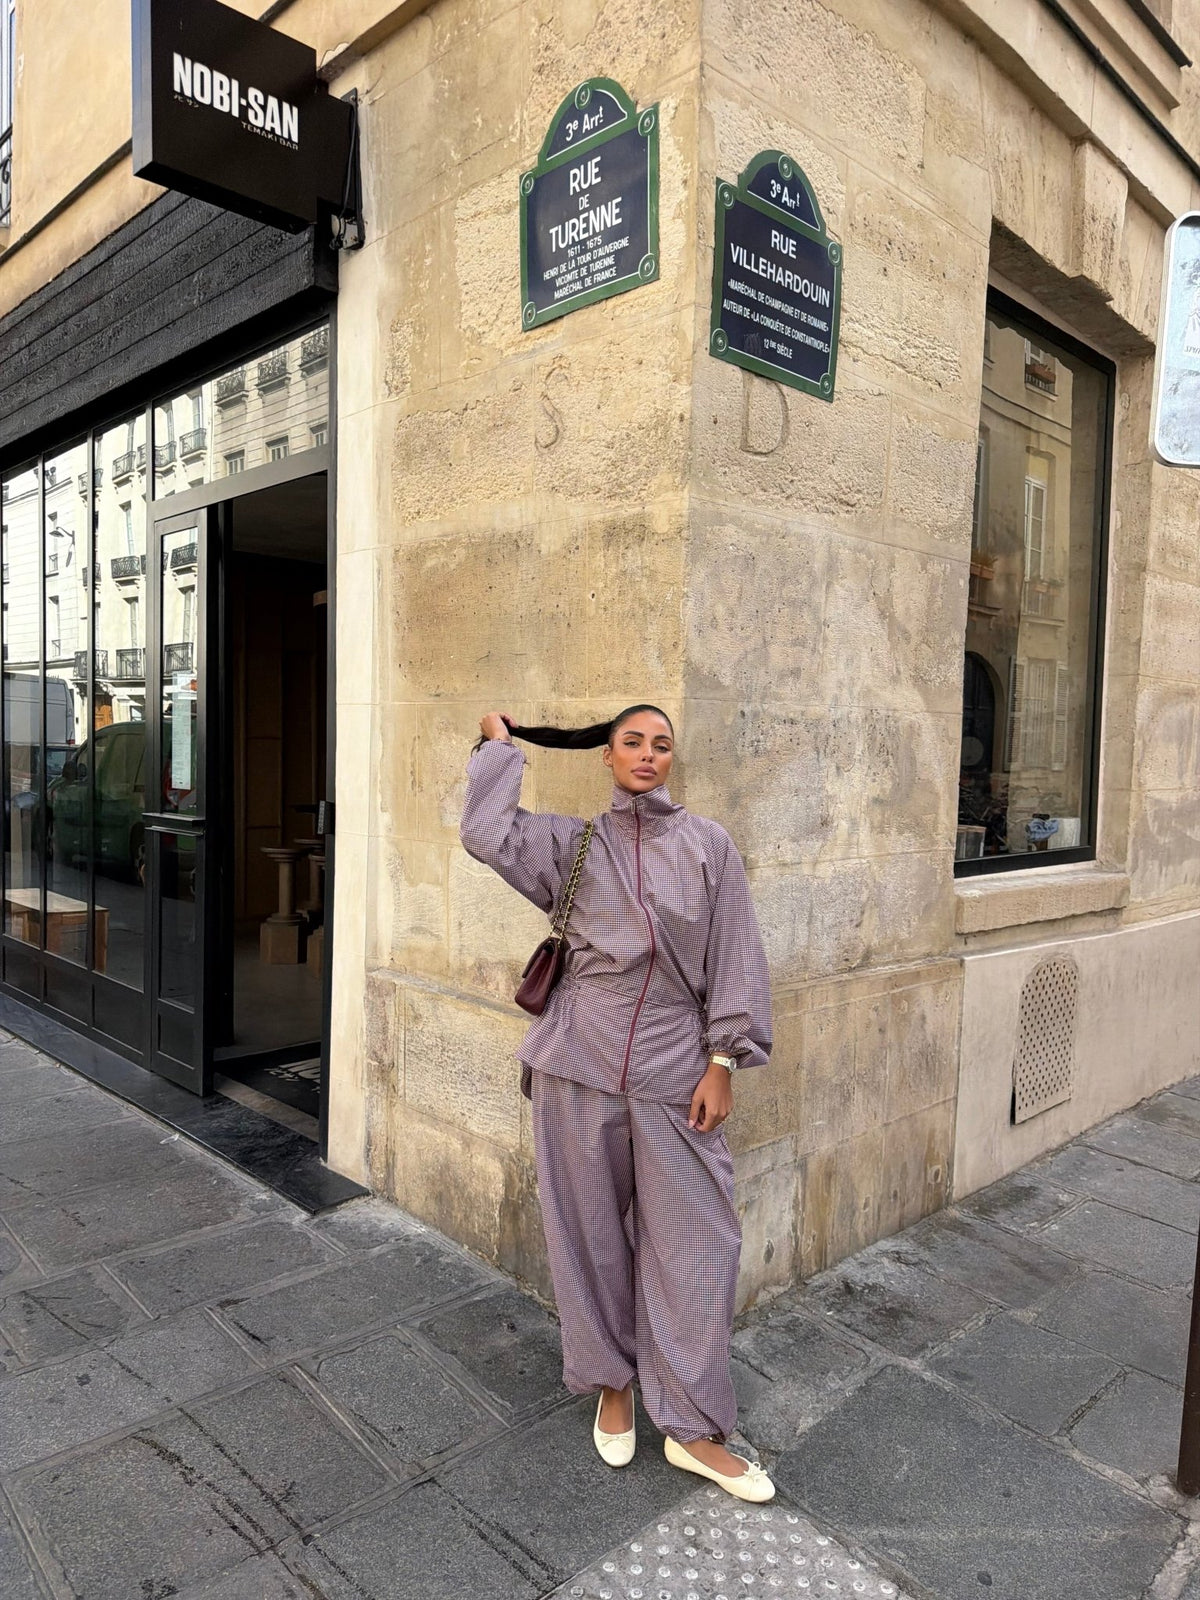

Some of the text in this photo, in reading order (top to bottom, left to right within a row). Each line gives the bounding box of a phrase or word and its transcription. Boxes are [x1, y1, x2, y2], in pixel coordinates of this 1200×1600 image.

[173, 51, 299, 144] NOBI-SAN
[241, 121, 299, 151] TEMAKI BAR
[565, 119, 579, 142] 3e
[569, 156, 602, 196] RUE
[770, 179, 782, 199] 3e
[578, 193, 590, 211] DE
[549, 197, 622, 253] TURENNE
[543, 236, 630, 281] HENRI DE LA TOUR D'AUVERGNE
[567, 244, 581, 258] 1611
[586, 235, 602, 250] 1675
[771, 229, 797, 260] RUE
[553, 266, 617, 300] MARÉCHAL DE FRANCE
[555, 254, 616, 287] VICOMTE DE TURENNE
[730, 242, 830, 308] VILLEHARDOUIN
[722, 298, 743, 316] AUTEUR
[743, 307, 751, 319] DE
[760, 314, 785, 334] CONQUÊTE
[784, 325, 791, 337] DE
[757, 291, 765, 304] DE
[764, 295, 794, 318] CHAMPAGNE
[794, 309, 801, 320] ET
[800, 311, 807, 323] DE
[776, 342, 793, 359] SIÈCLE
